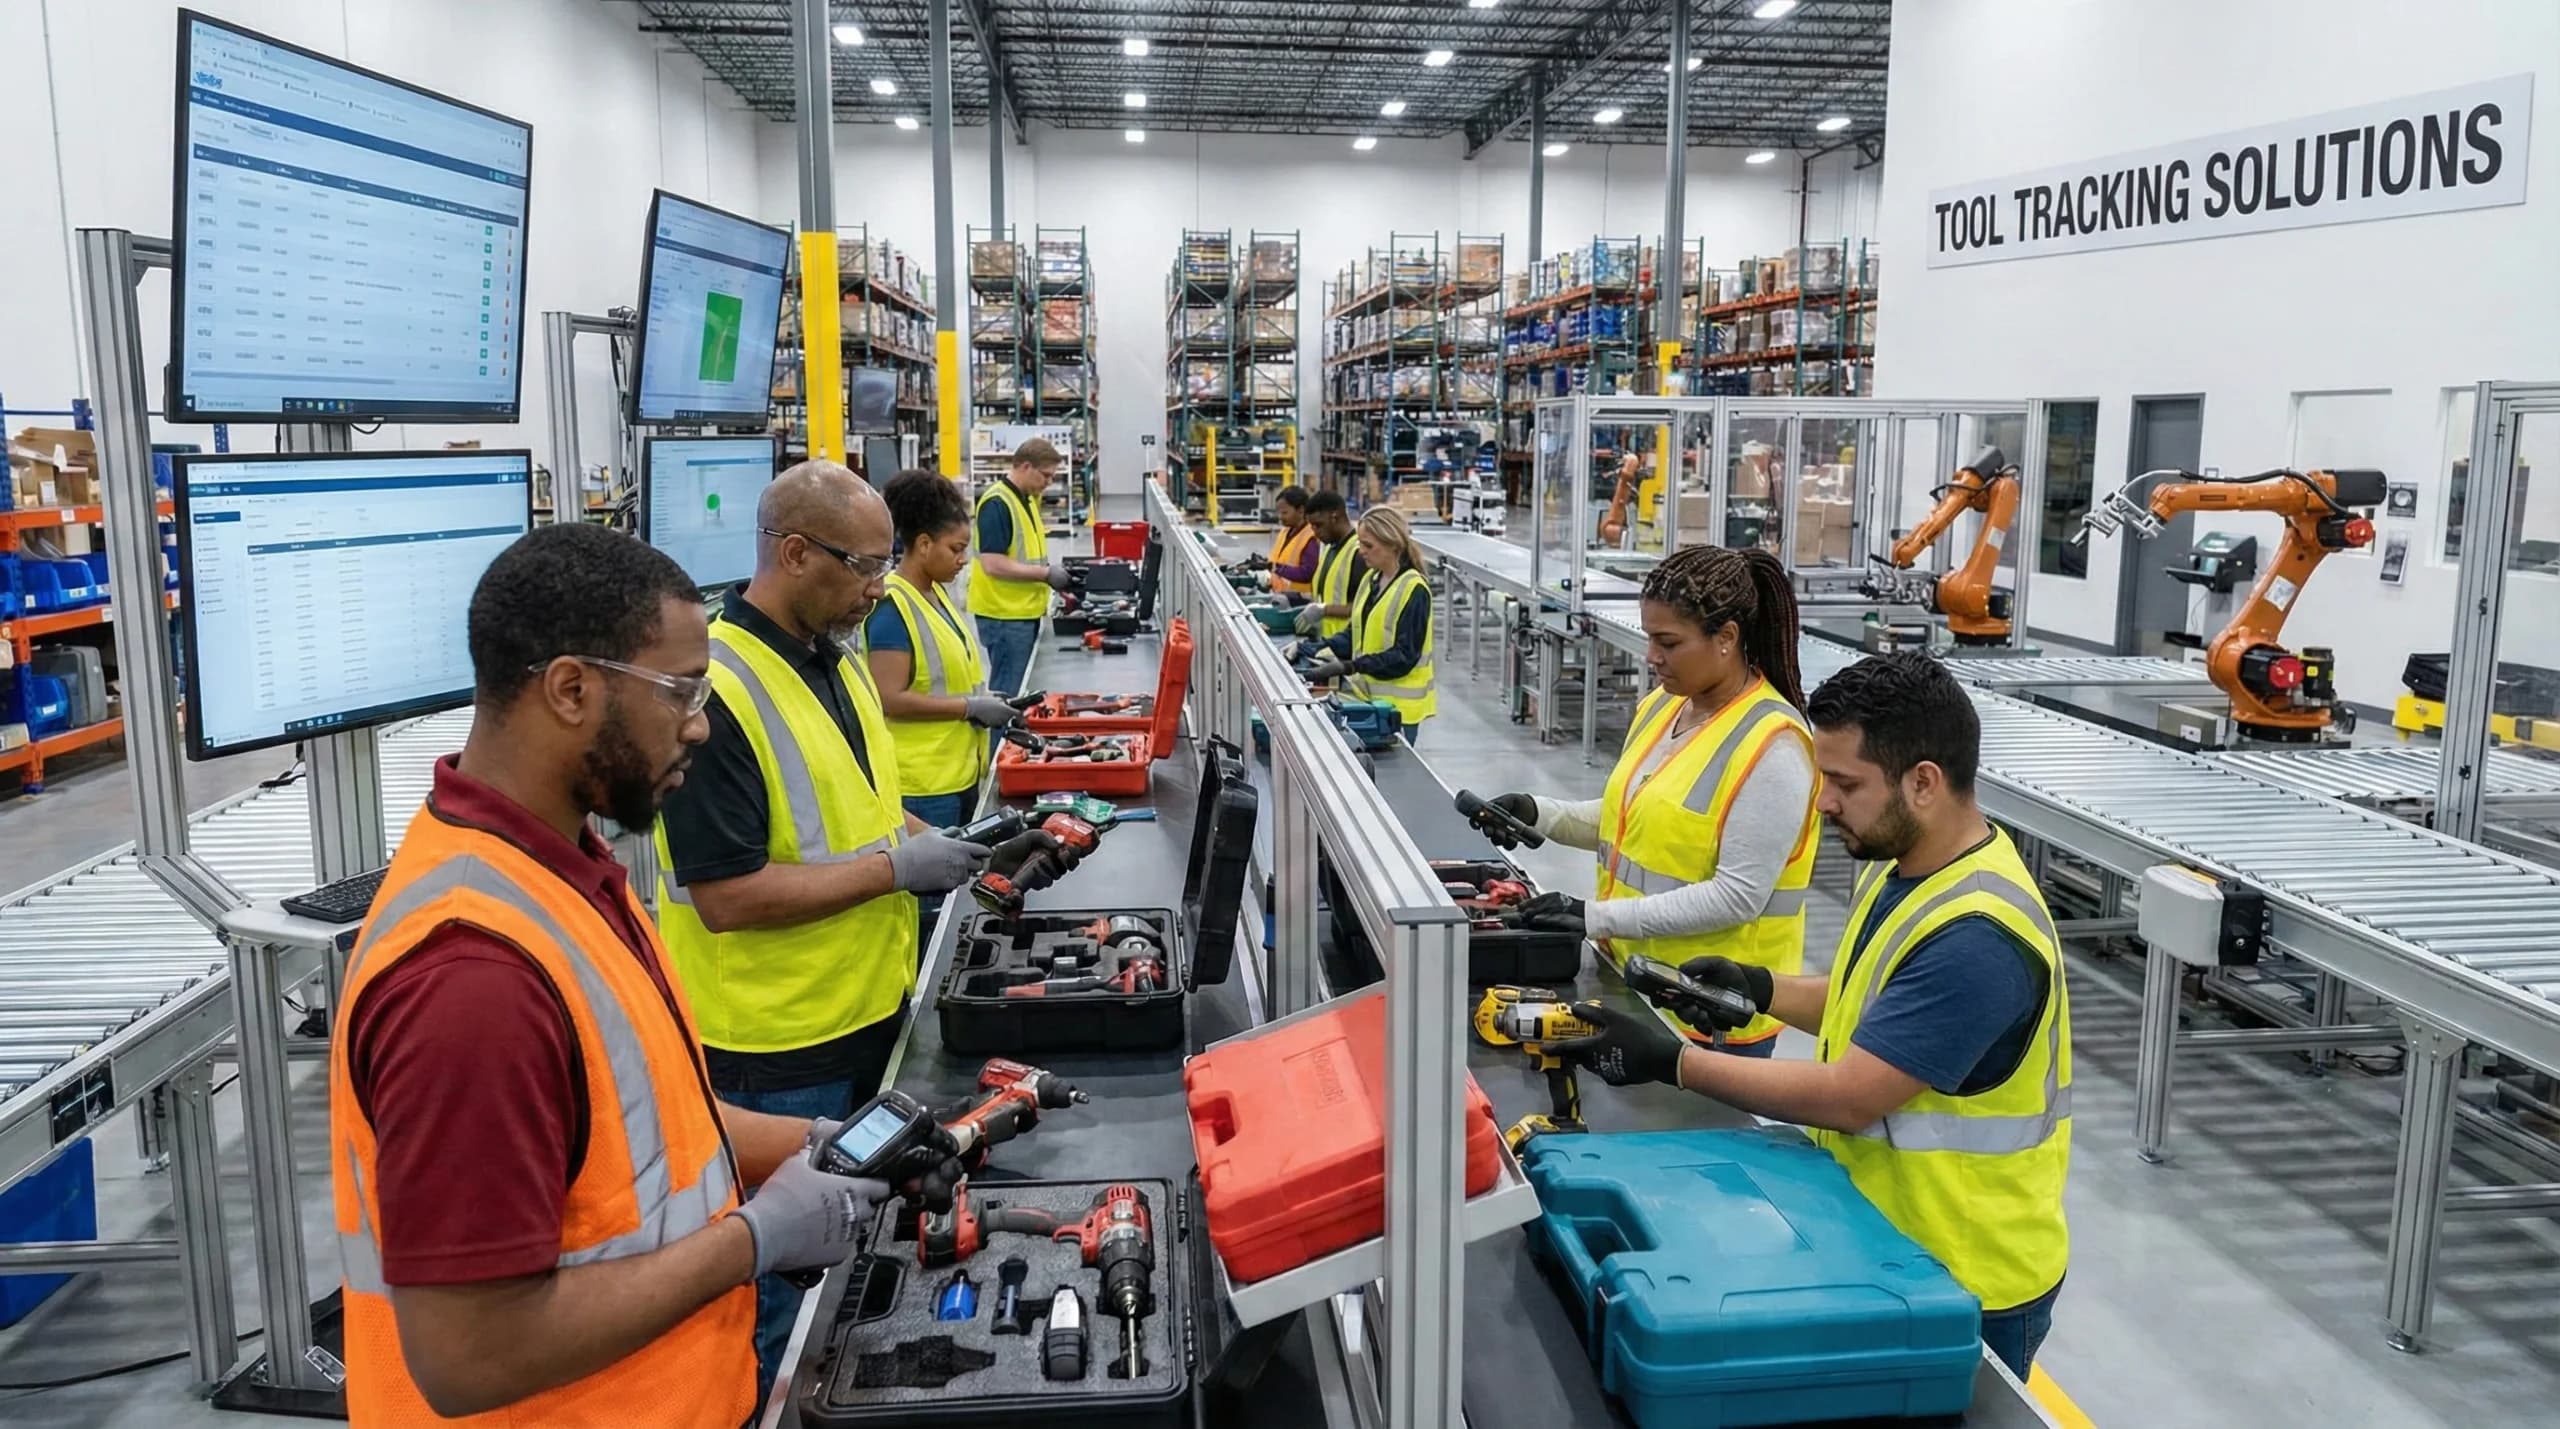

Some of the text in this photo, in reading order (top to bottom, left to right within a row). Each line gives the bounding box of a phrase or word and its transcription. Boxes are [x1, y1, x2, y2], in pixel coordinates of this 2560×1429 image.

[1935, 103, 2503, 252] TOOL TRACKING SOLUTIONS
